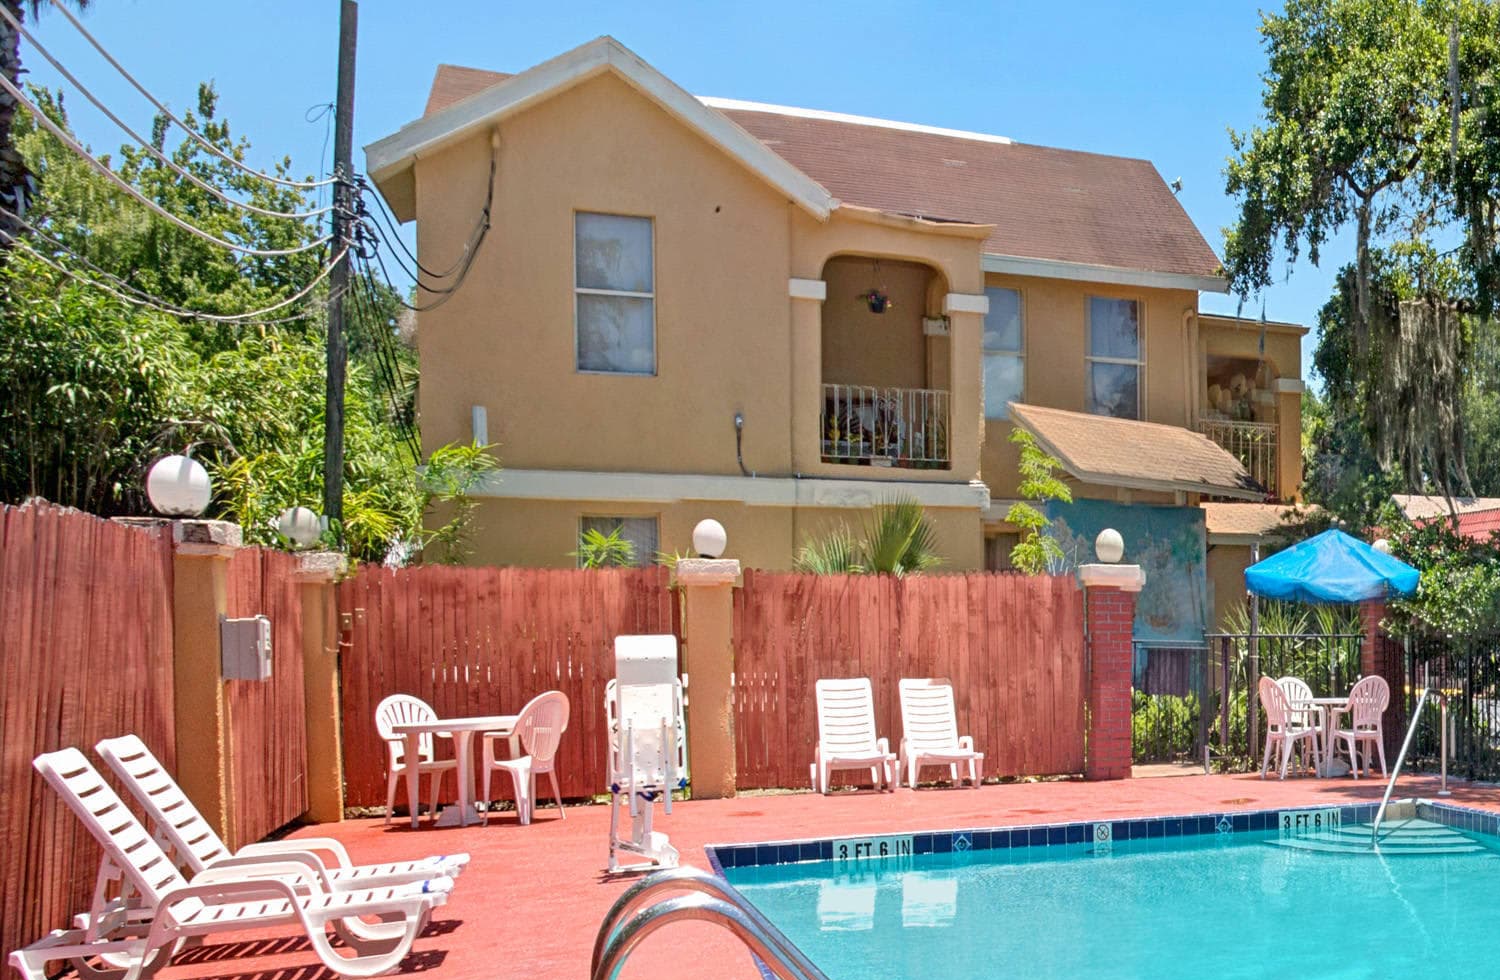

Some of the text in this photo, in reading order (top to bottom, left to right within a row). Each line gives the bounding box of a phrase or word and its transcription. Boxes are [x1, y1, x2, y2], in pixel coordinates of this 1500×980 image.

[1283, 810, 1339, 829] 3 FT 6 IN
[839, 839, 911, 859] 3 FT 6 IN
